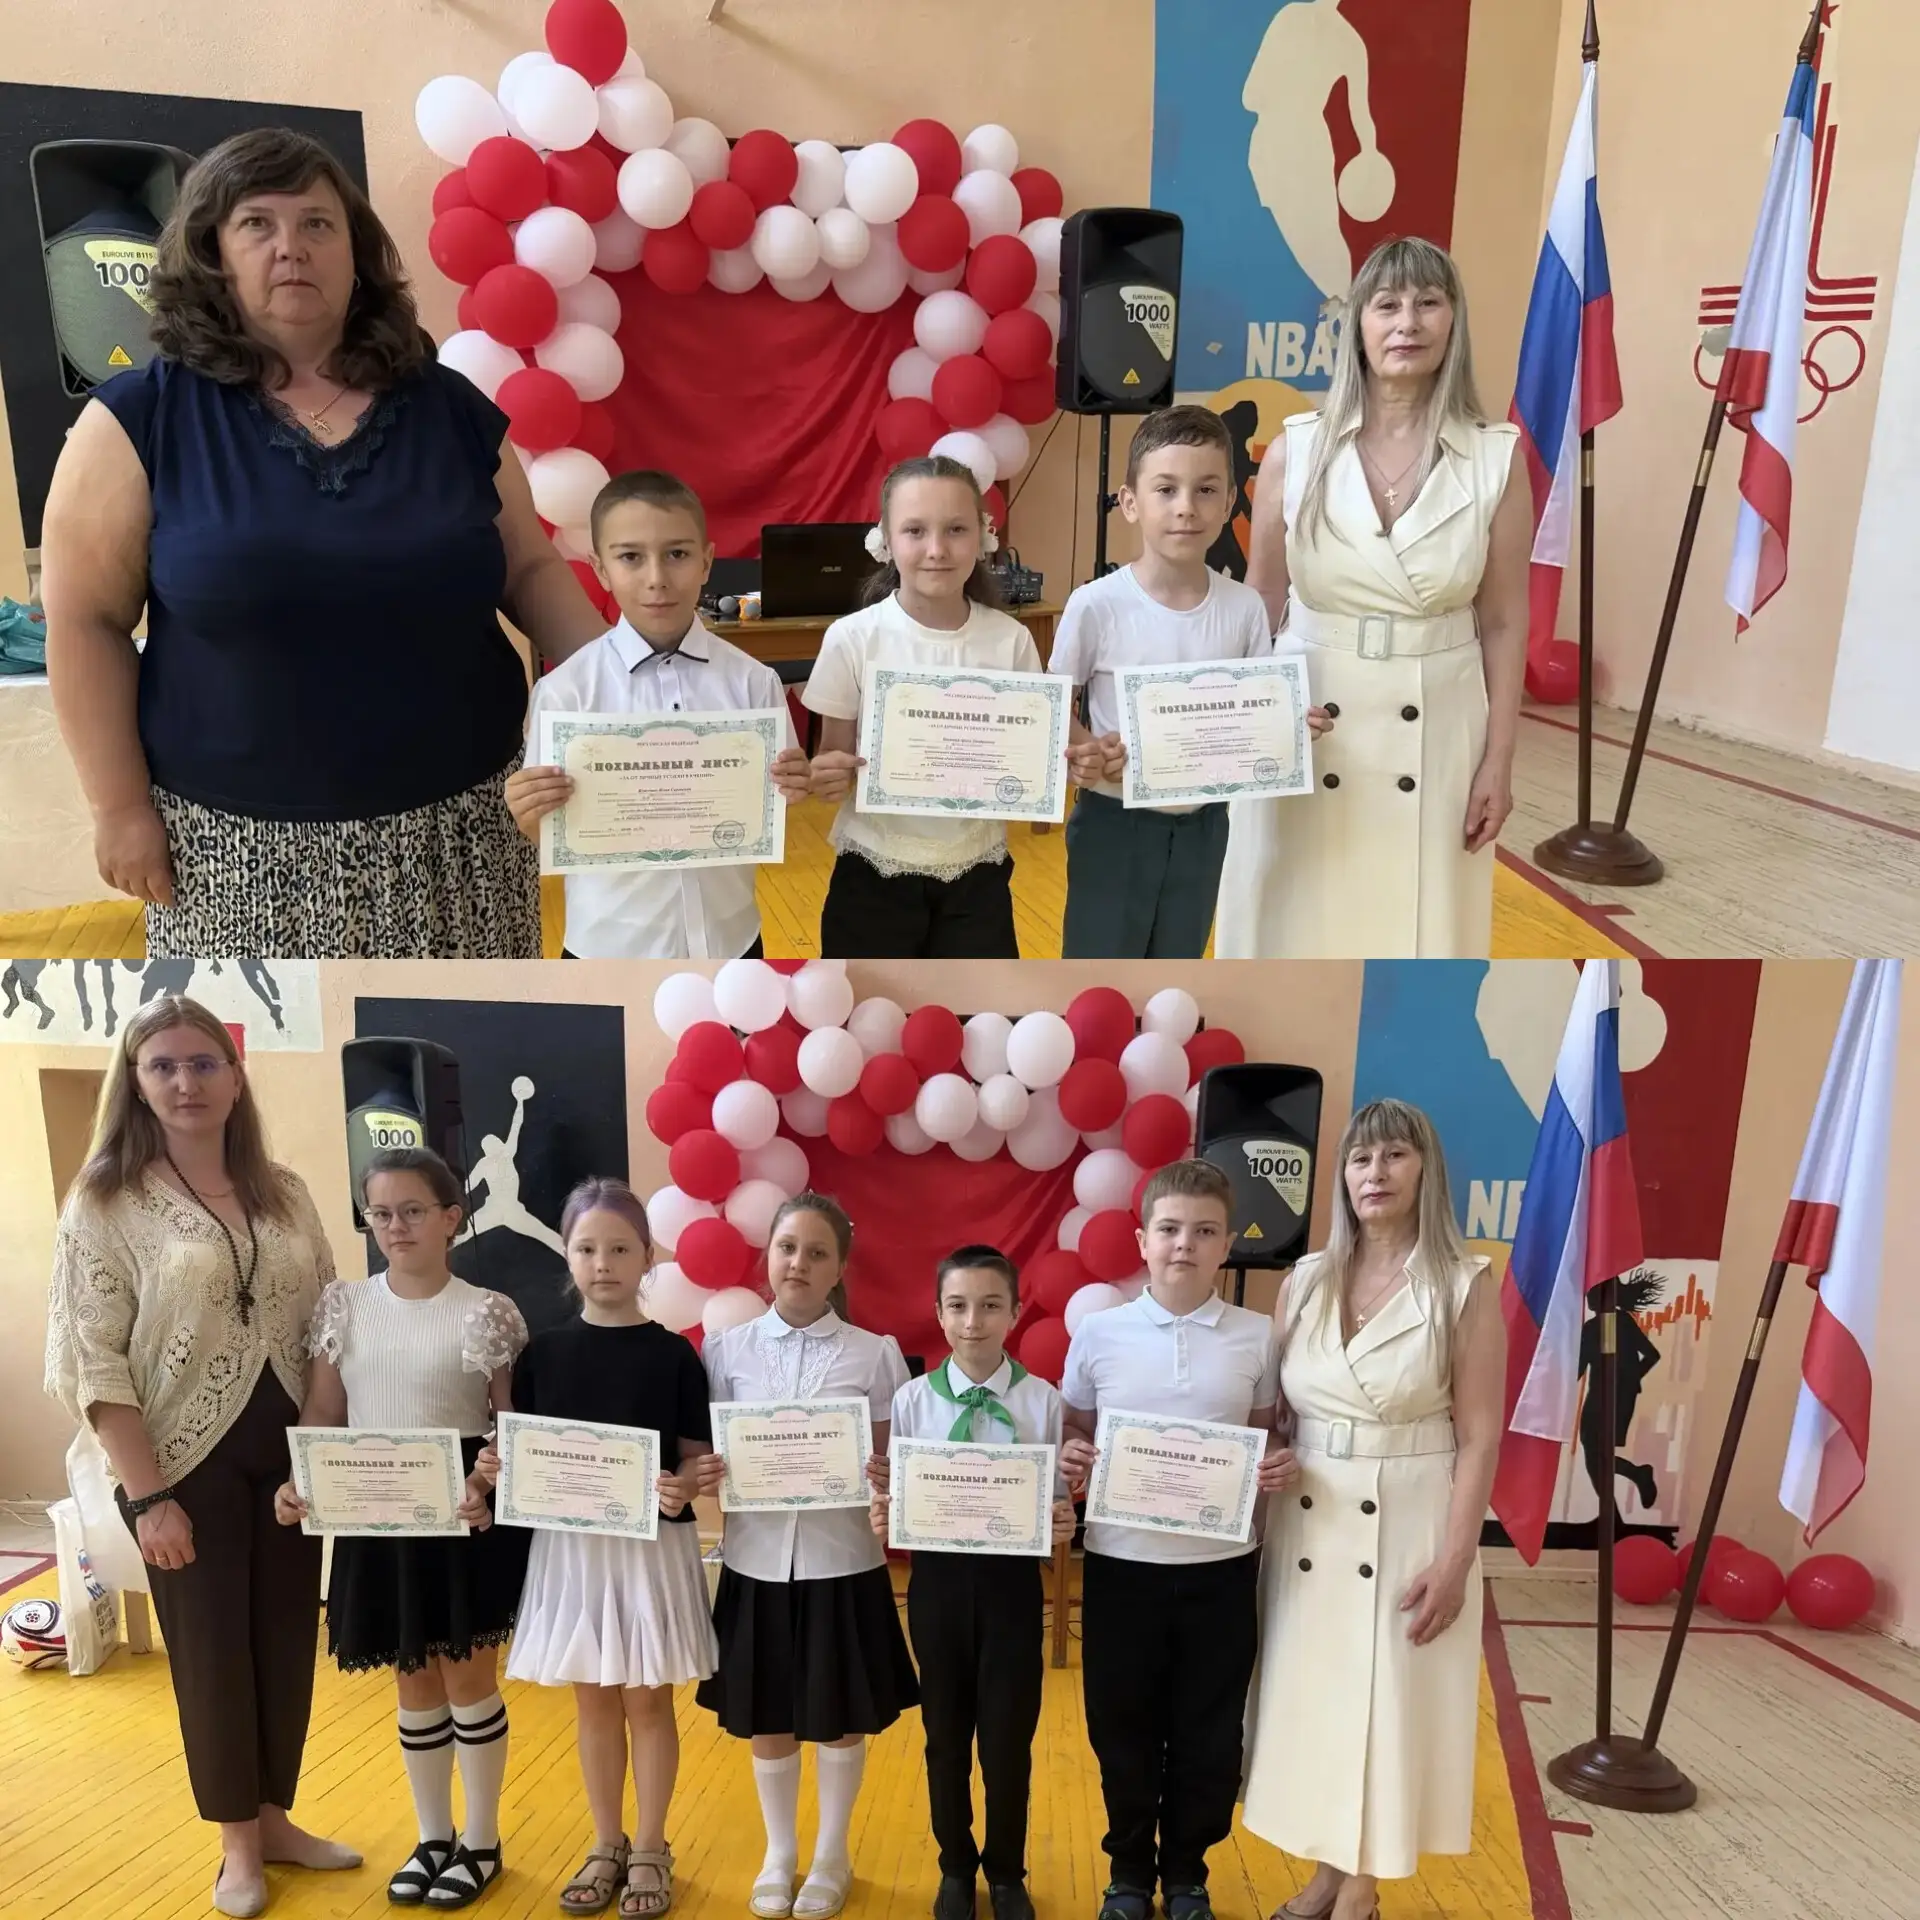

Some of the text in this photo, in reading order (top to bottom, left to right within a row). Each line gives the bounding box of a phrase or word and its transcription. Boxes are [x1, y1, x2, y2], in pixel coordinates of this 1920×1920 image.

[95, 262, 156, 288] 100
[1126, 303, 1170, 322] 1000
[1149, 322, 1170, 330] WATTS
[1245, 321, 1334, 378] NBA
[1159, 698, 1272, 714] ПОХВАЛЬНЫЙ ЛИСТ
[908, 708, 1030, 725] ПОХВАЛЬНЫЙ ЛИСТ
[594, 758, 741, 772] ПОХВАЛЬНЫЙ ЛИСТ
[370, 1129, 415, 1147] 1000
[1249, 1157, 1303, 1177] 1000
[601, 1456, 628, 1465] ЛИСТ
[1131, 1446, 1196, 1461] ПОХВАЛЬНЫЙ
[1200, 1456, 1228, 1466] ЛИСТ
[923, 1473, 988, 1484] ПОХВАЛЬНЫЙ
